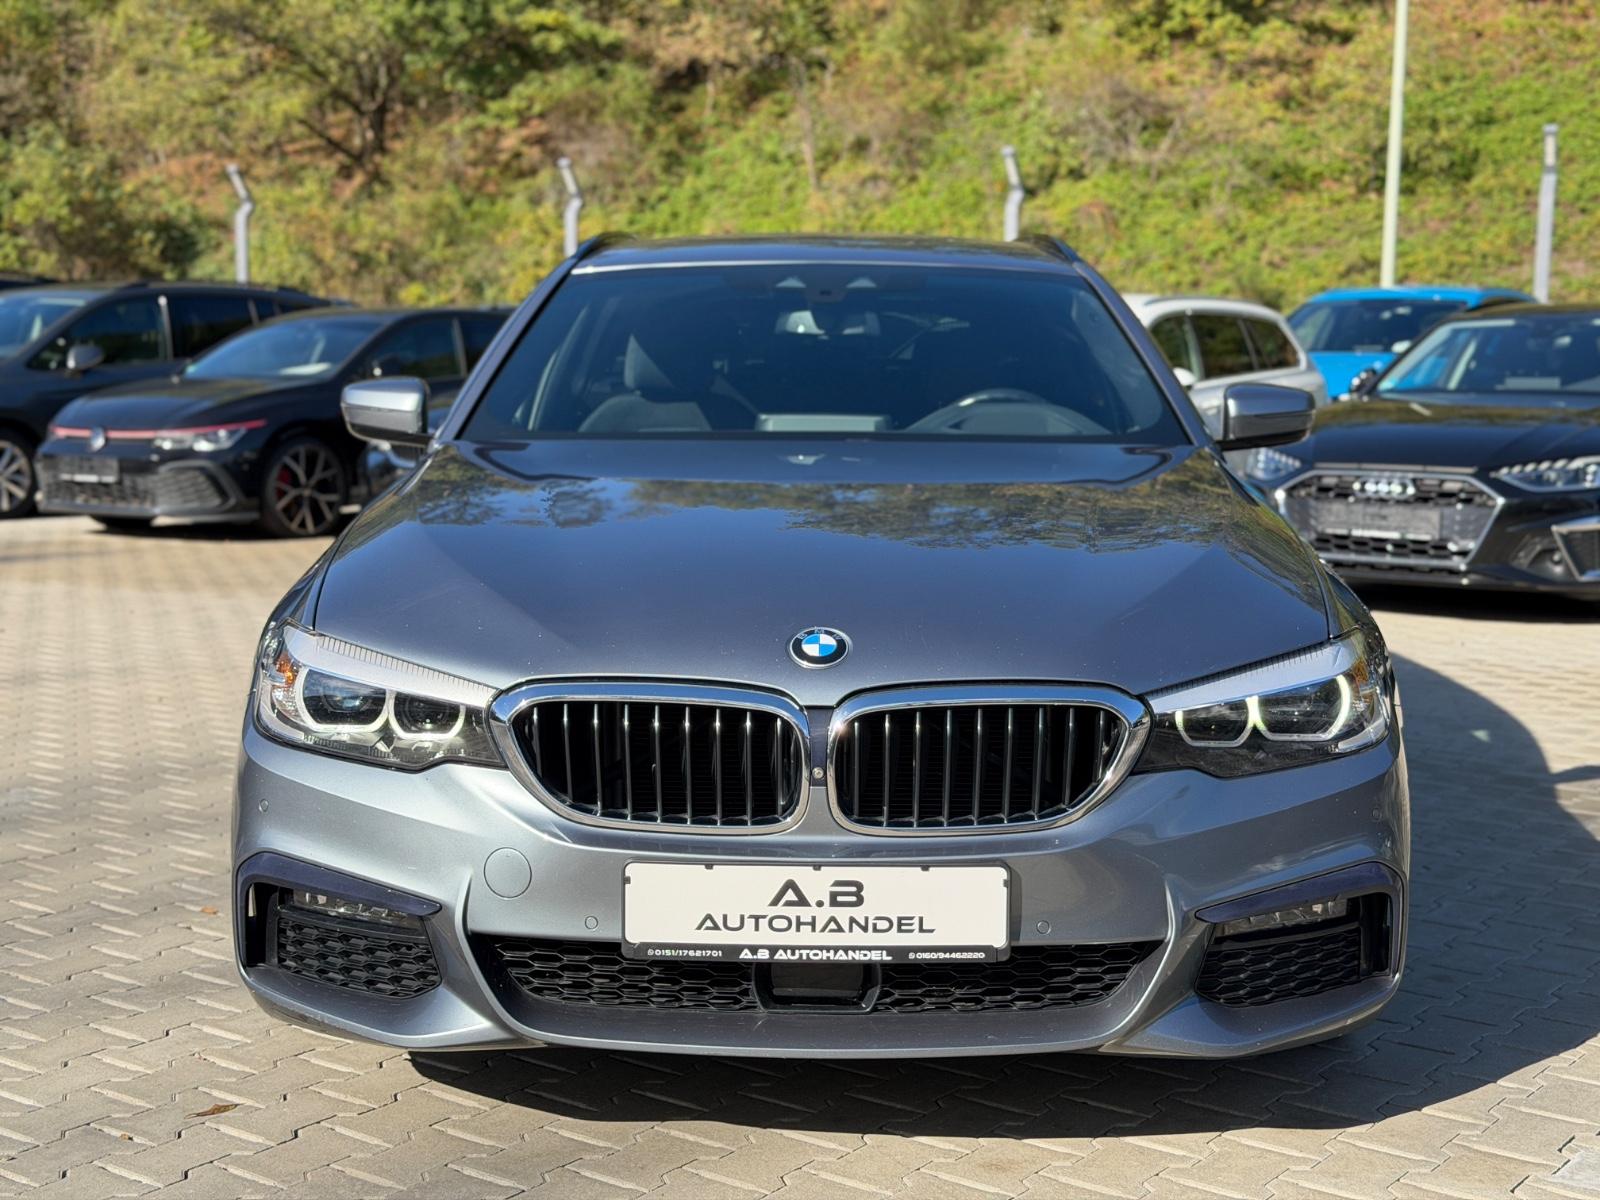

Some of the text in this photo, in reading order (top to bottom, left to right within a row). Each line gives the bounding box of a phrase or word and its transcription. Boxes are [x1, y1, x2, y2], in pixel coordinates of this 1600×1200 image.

[767, 878, 865, 908] A.B
[694, 913, 936, 934] AUTOHANDEL
[739, 948, 893, 961] A.B AUTOHANDEL
